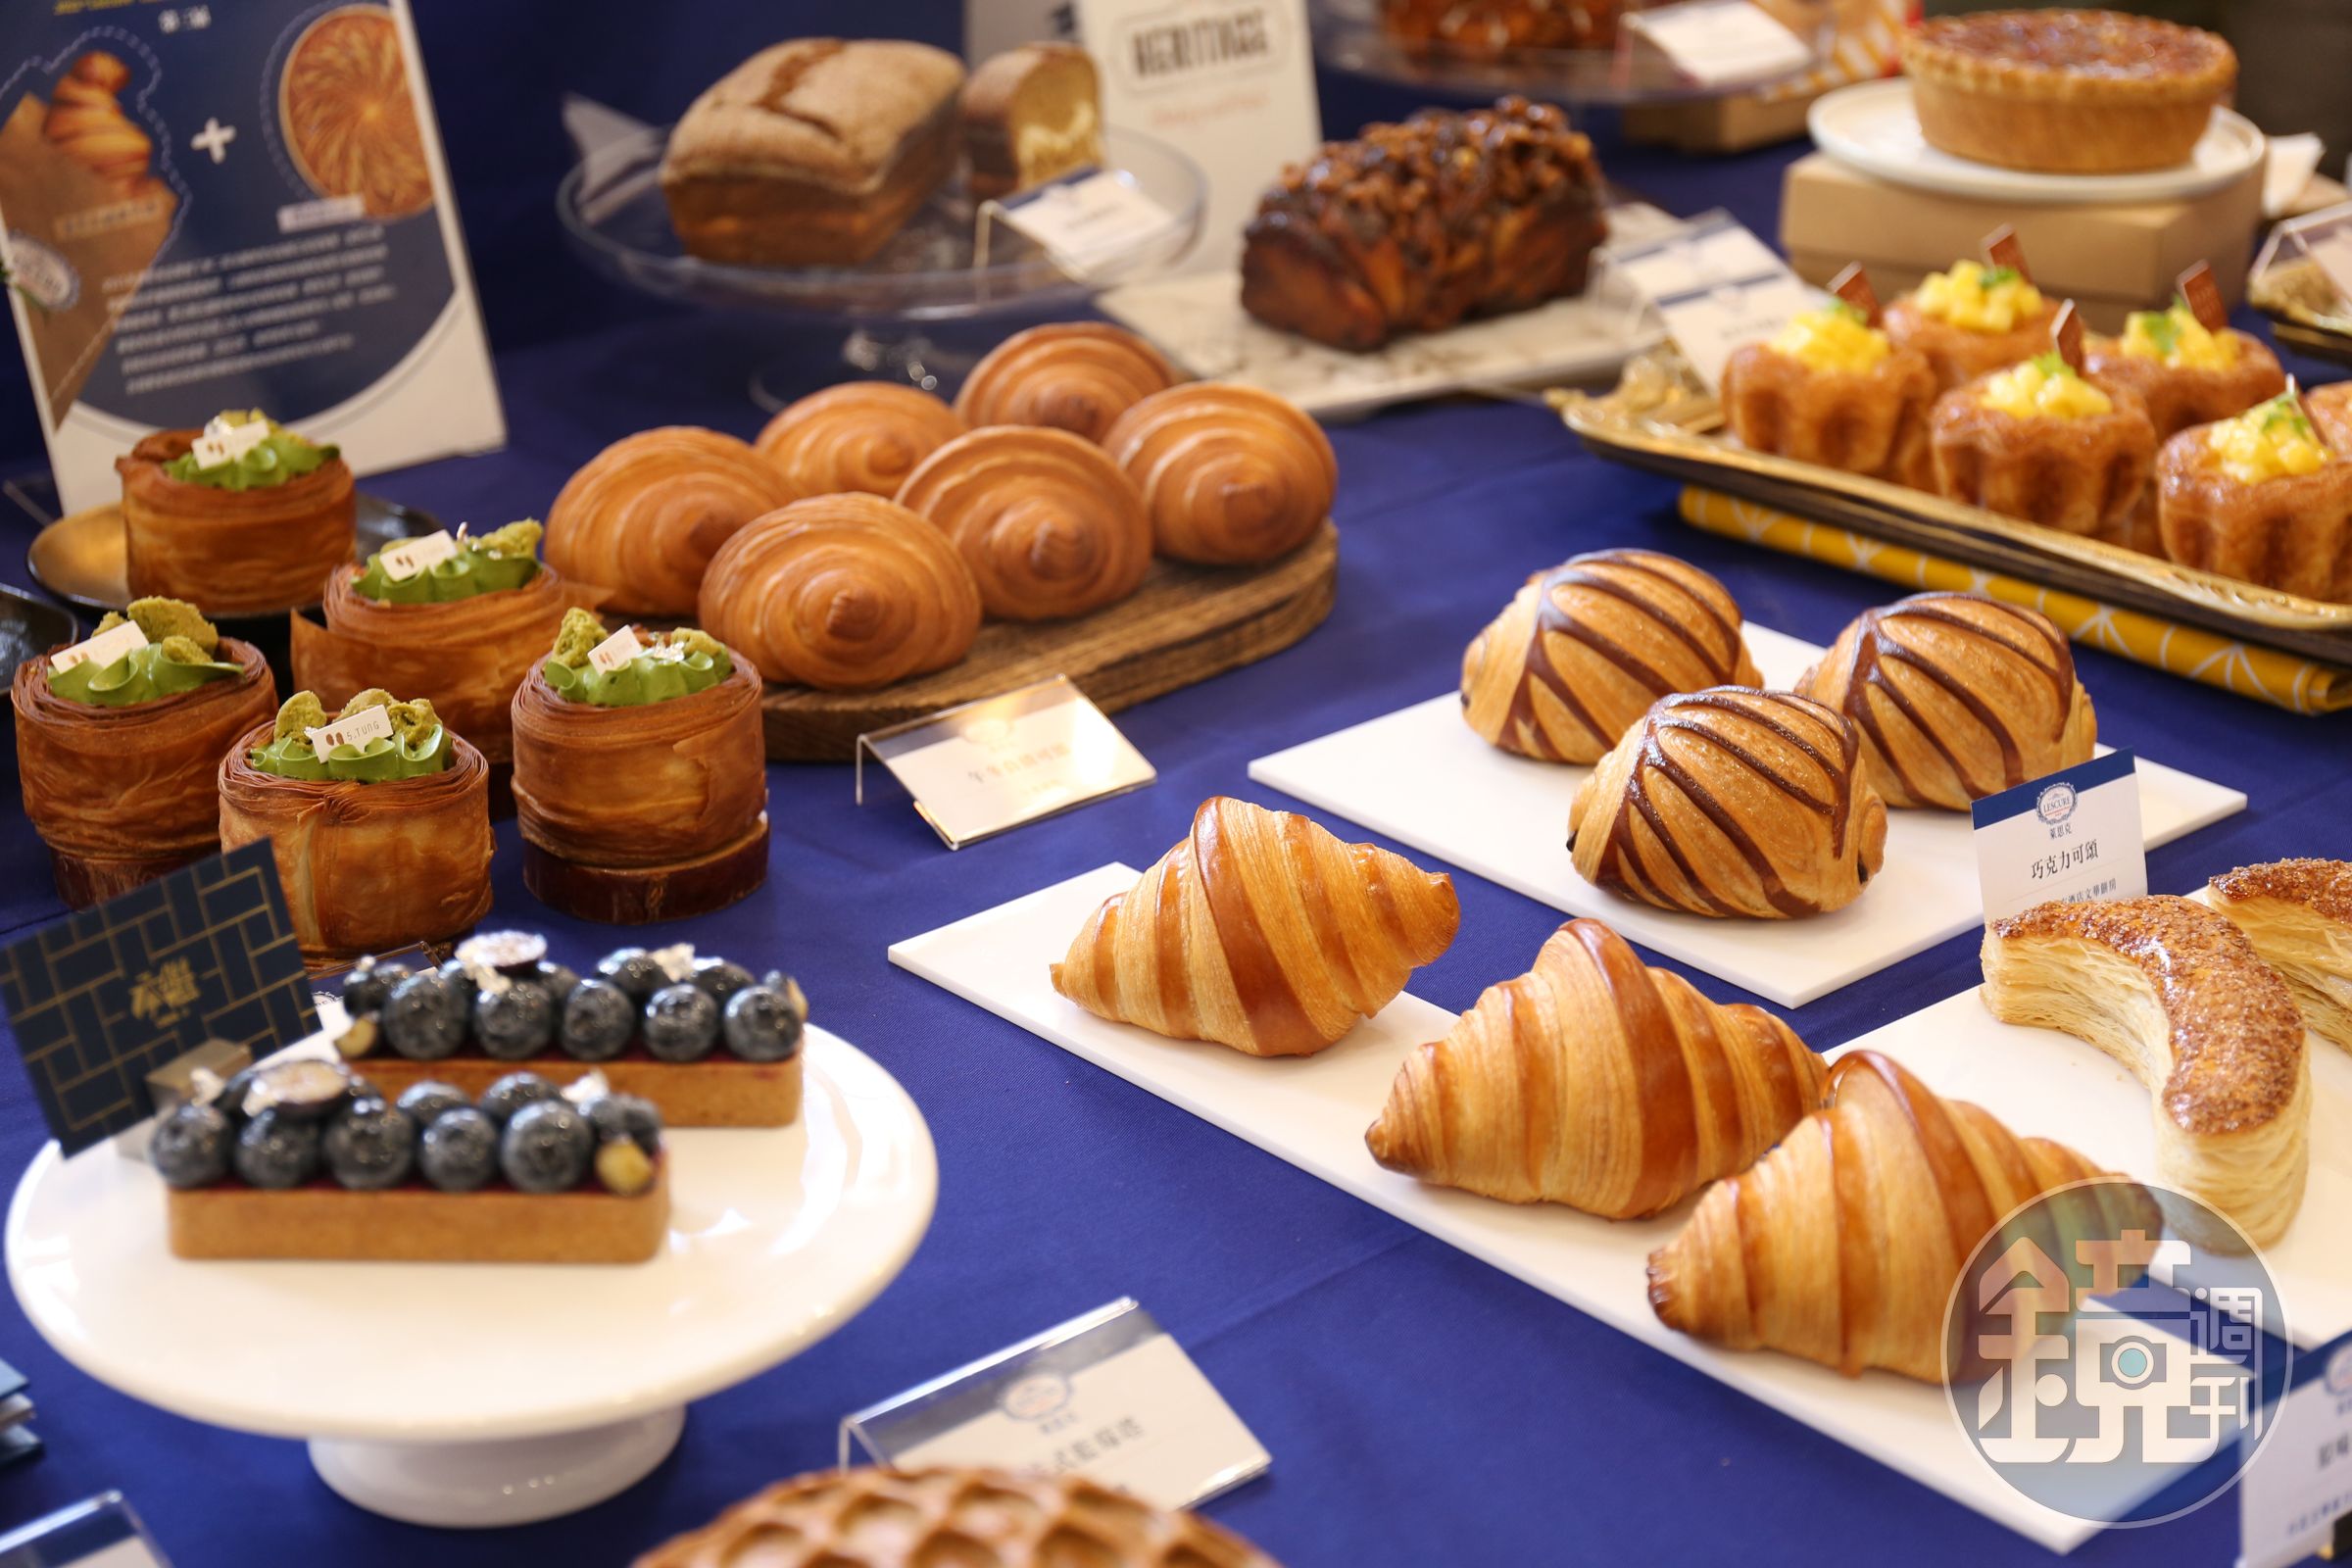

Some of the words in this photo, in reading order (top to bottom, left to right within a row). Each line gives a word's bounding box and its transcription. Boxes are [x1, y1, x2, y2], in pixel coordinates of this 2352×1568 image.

[2043, 796, 2071, 813] LESCURE
[2032, 839, 2099, 879] 巧克力可頌
